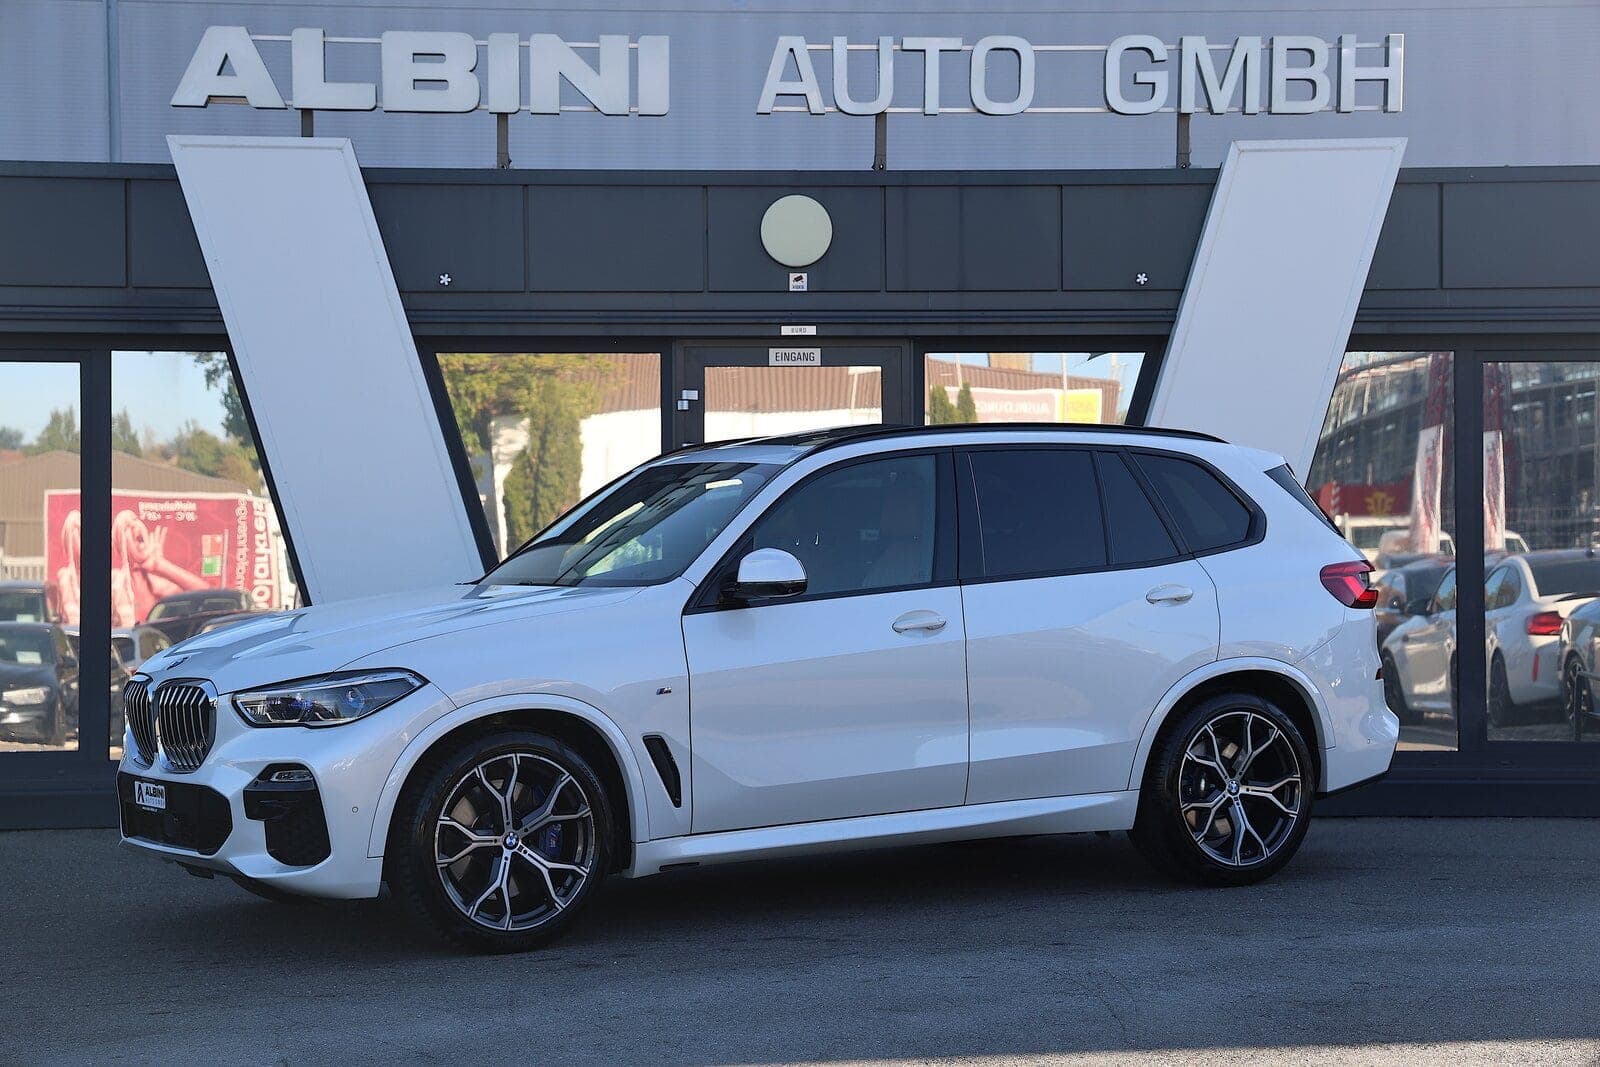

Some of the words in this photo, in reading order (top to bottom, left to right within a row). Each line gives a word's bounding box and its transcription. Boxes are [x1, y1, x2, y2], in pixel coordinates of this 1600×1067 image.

[170, 26, 670, 116] ALBINI
[756, 34, 1036, 116] AUTO
[1105, 33, 1404, 116] GMBH
[775, 351, 815, 362] EINGANG
